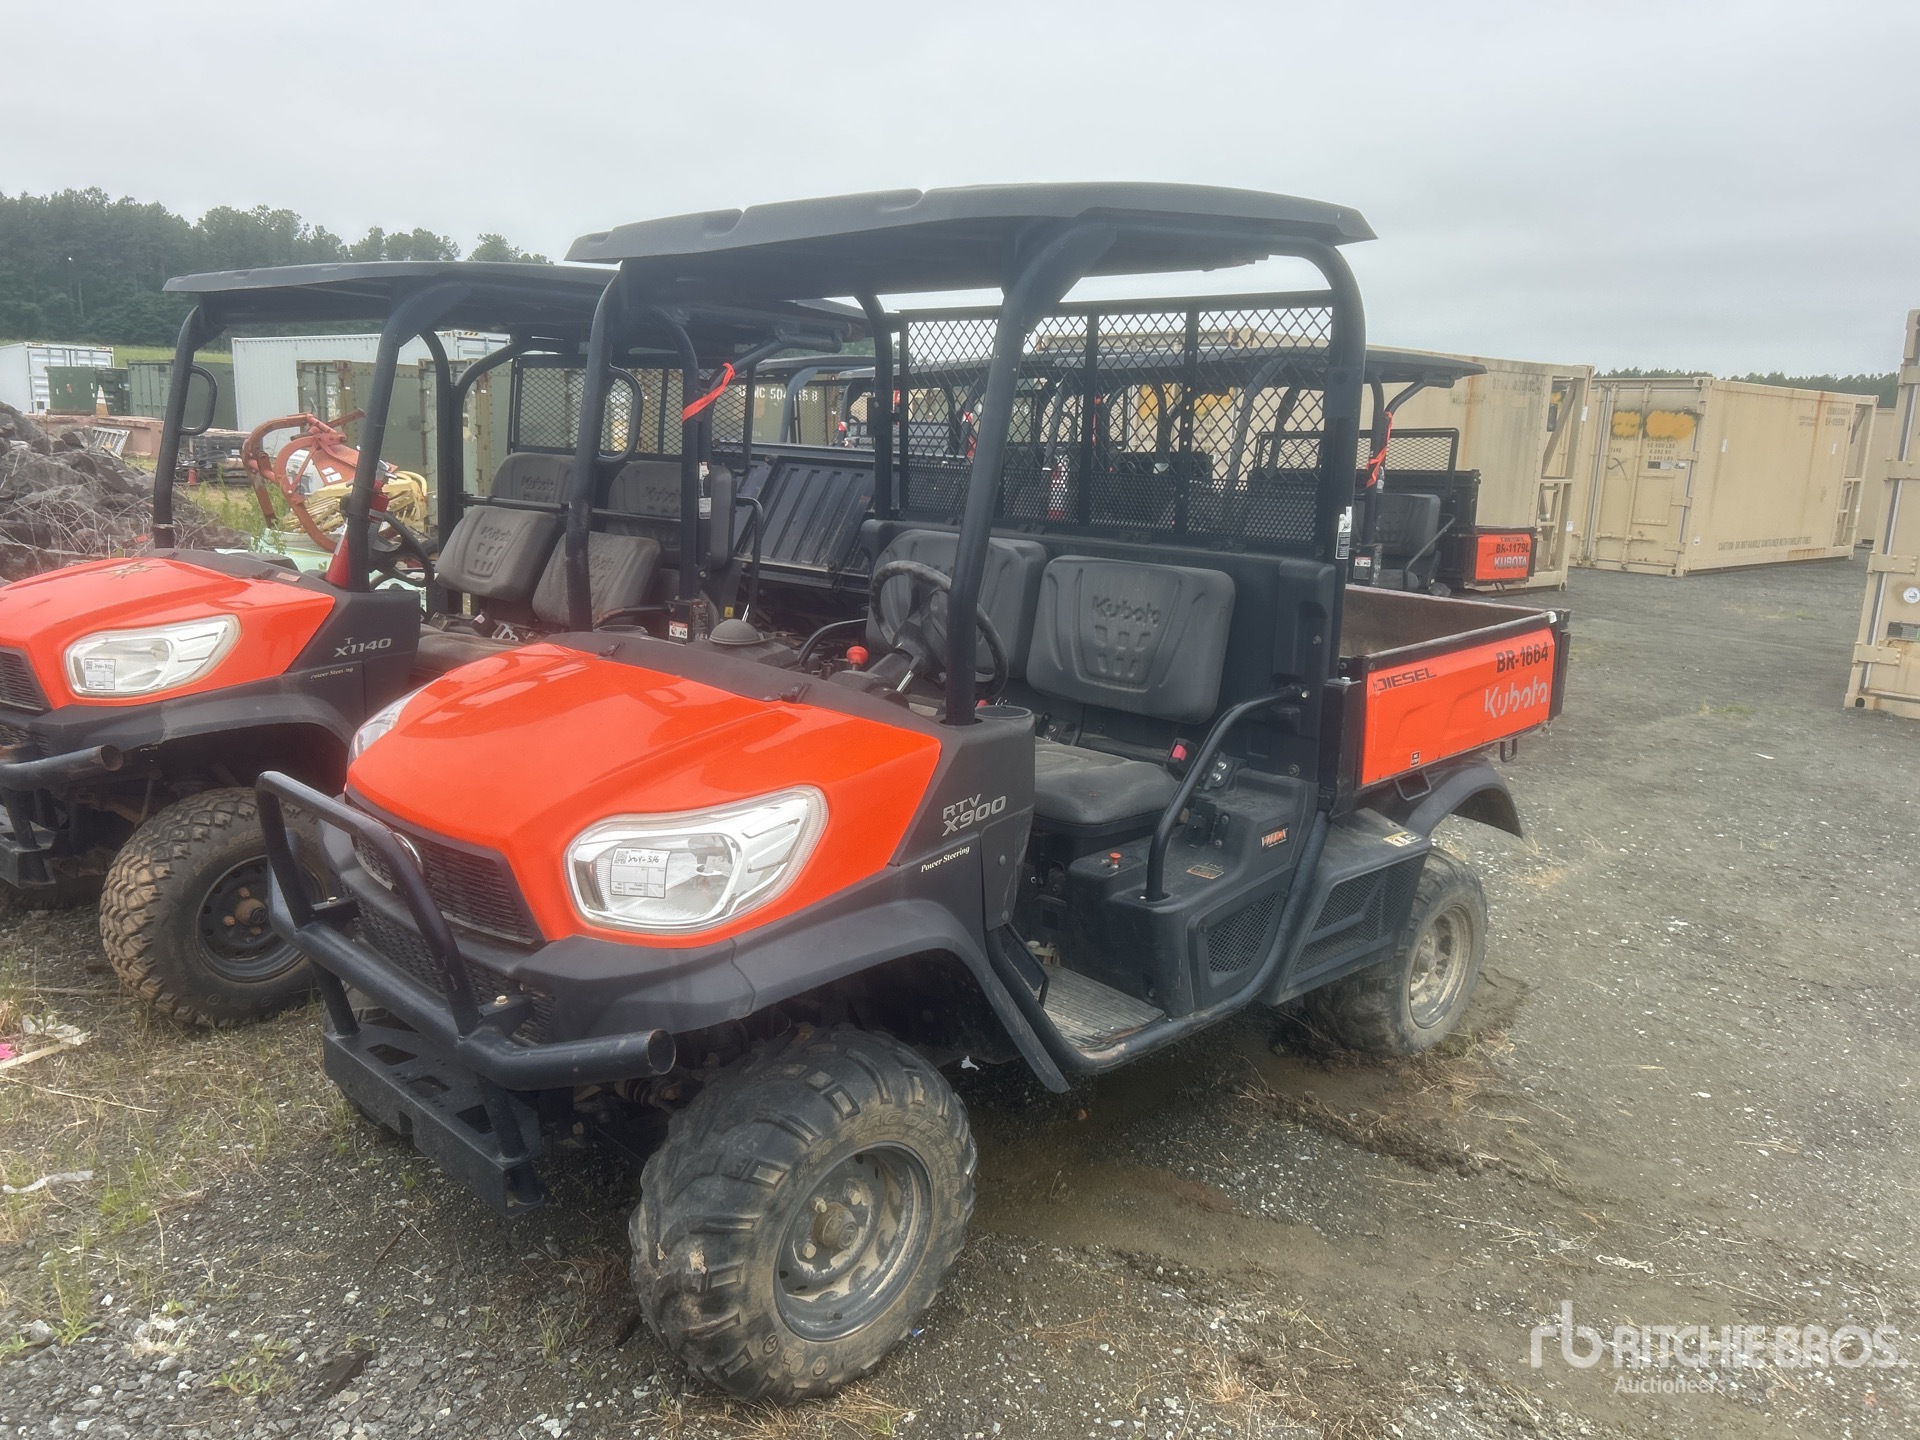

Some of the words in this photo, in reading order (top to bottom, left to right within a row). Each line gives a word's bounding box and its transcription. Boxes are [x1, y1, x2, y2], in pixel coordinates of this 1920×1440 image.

[1494, 556, 1527, 569] KUBOTA
[333, 638, 392, 657] X1140
[1496, 642, 1548, 673] BR-1664
[1374, 668, 1437, 691] DIESEL
[1484, 676, 1548, 718] Kubota
[942, 795, 1006, 837] X900
[943, 793, 981, 819] RTV
[921, 858, 943, 873] Power
[942, 846, 970, 863] Steering
